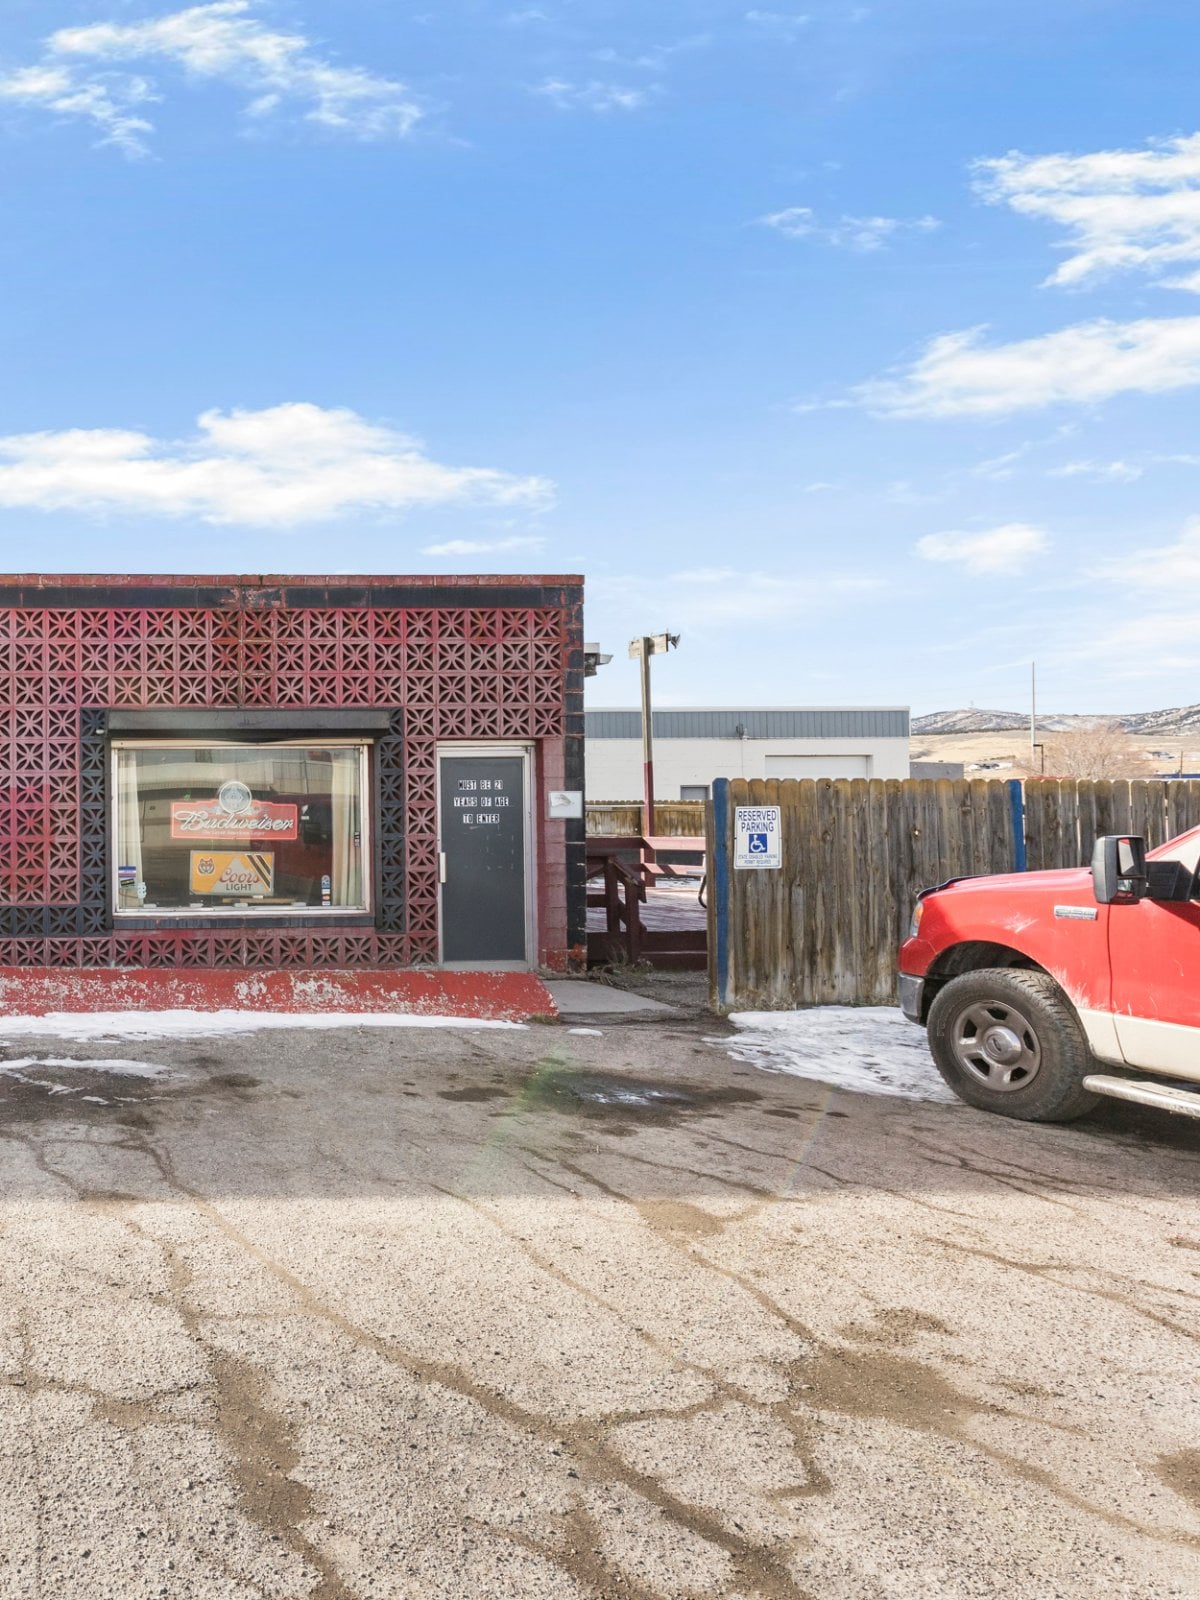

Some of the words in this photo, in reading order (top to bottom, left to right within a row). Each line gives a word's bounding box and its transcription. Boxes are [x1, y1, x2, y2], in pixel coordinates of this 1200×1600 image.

[458, 780, 476, 790] MUST
[480, 780, 491, 790] BE
[454, 797, 477, 806] YEARS
[480, 797, 492, 806] OF
[495, 797, 509, 806] AGE
[175, 811, 294, 831] Budweiser
[463, 814, 473, 824] TO
[477, 814, 499, 824] ENTER
[738, 810, 776, 821] RESERVED
[741, 821, 774, 832] PARKING
[219, 868, 260, 883] Coors
